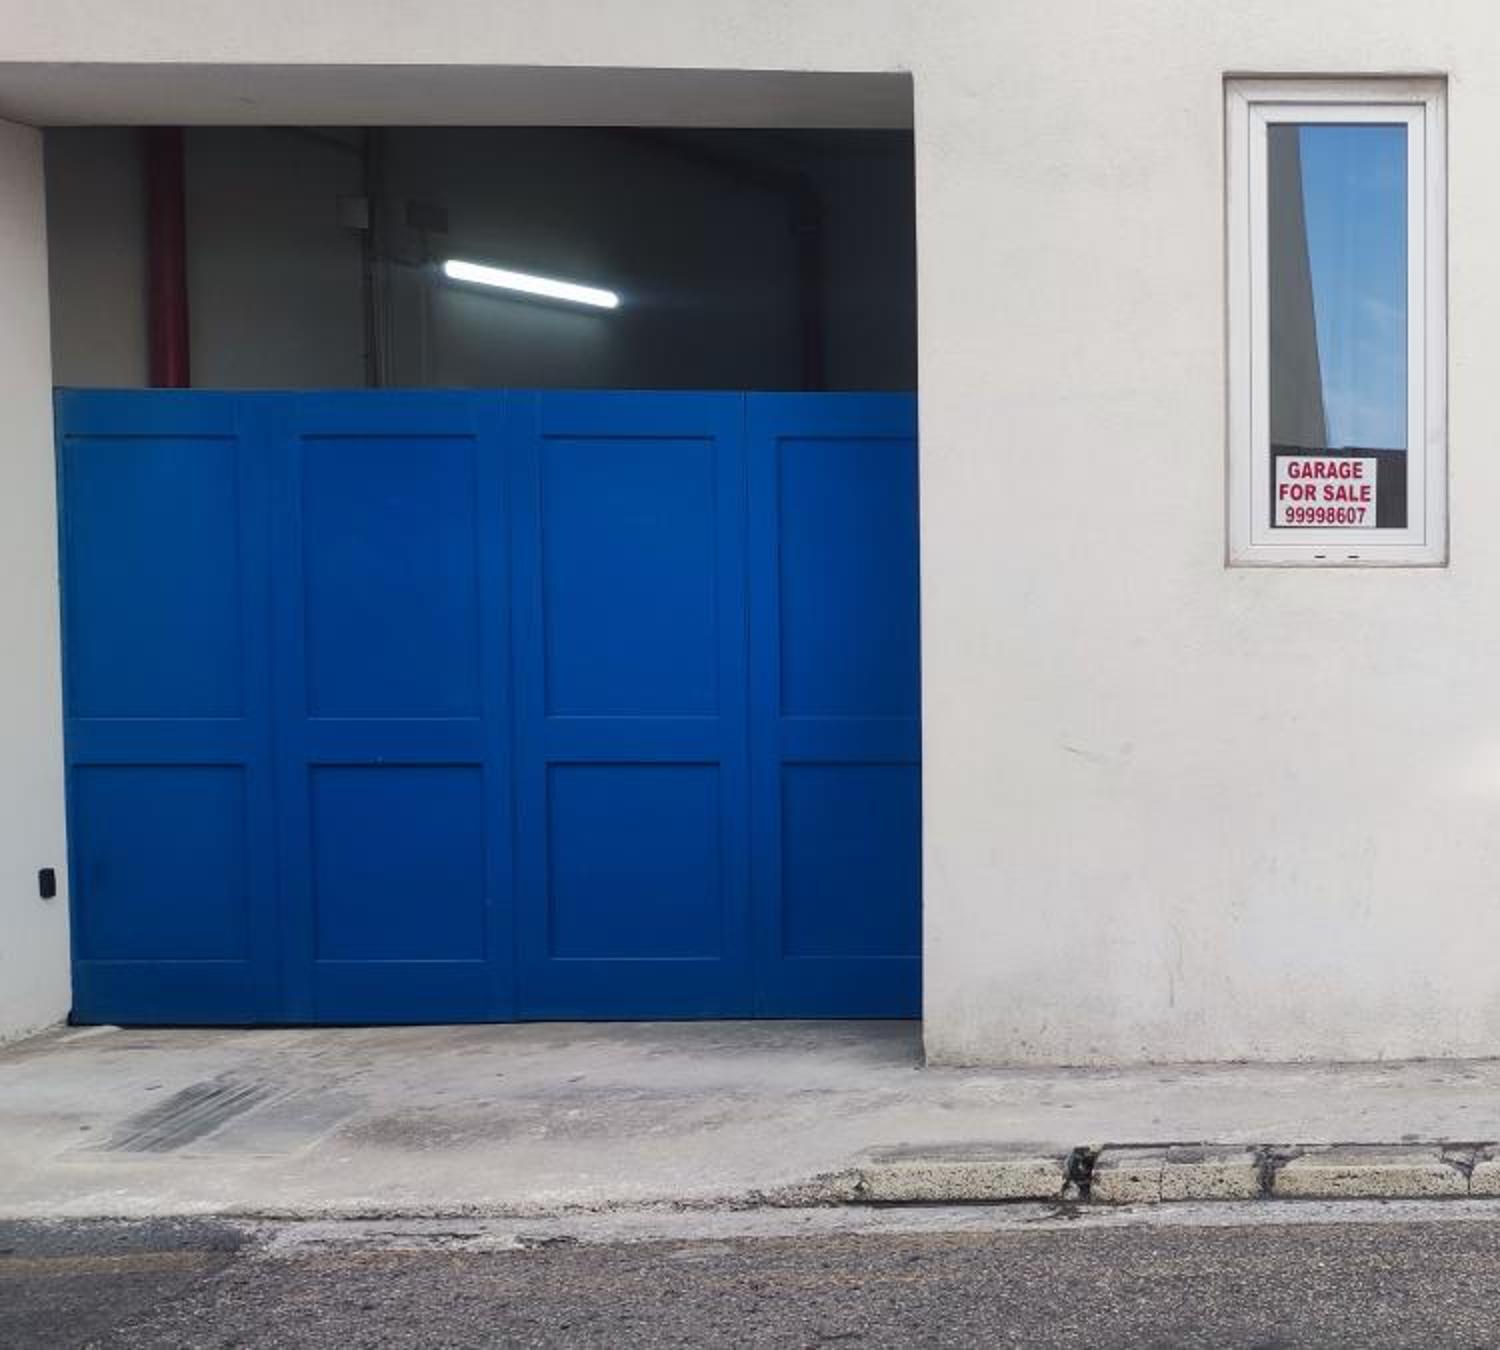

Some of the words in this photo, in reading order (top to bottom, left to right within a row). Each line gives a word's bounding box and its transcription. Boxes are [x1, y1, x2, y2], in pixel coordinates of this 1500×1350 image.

[1288, 461, 1363, 479] GARAGE
[1279, 483, 1317, 501] FOR
[1323, 484, 1371, 502] SALE
[1285, 506, 1366, 524] 99998607
